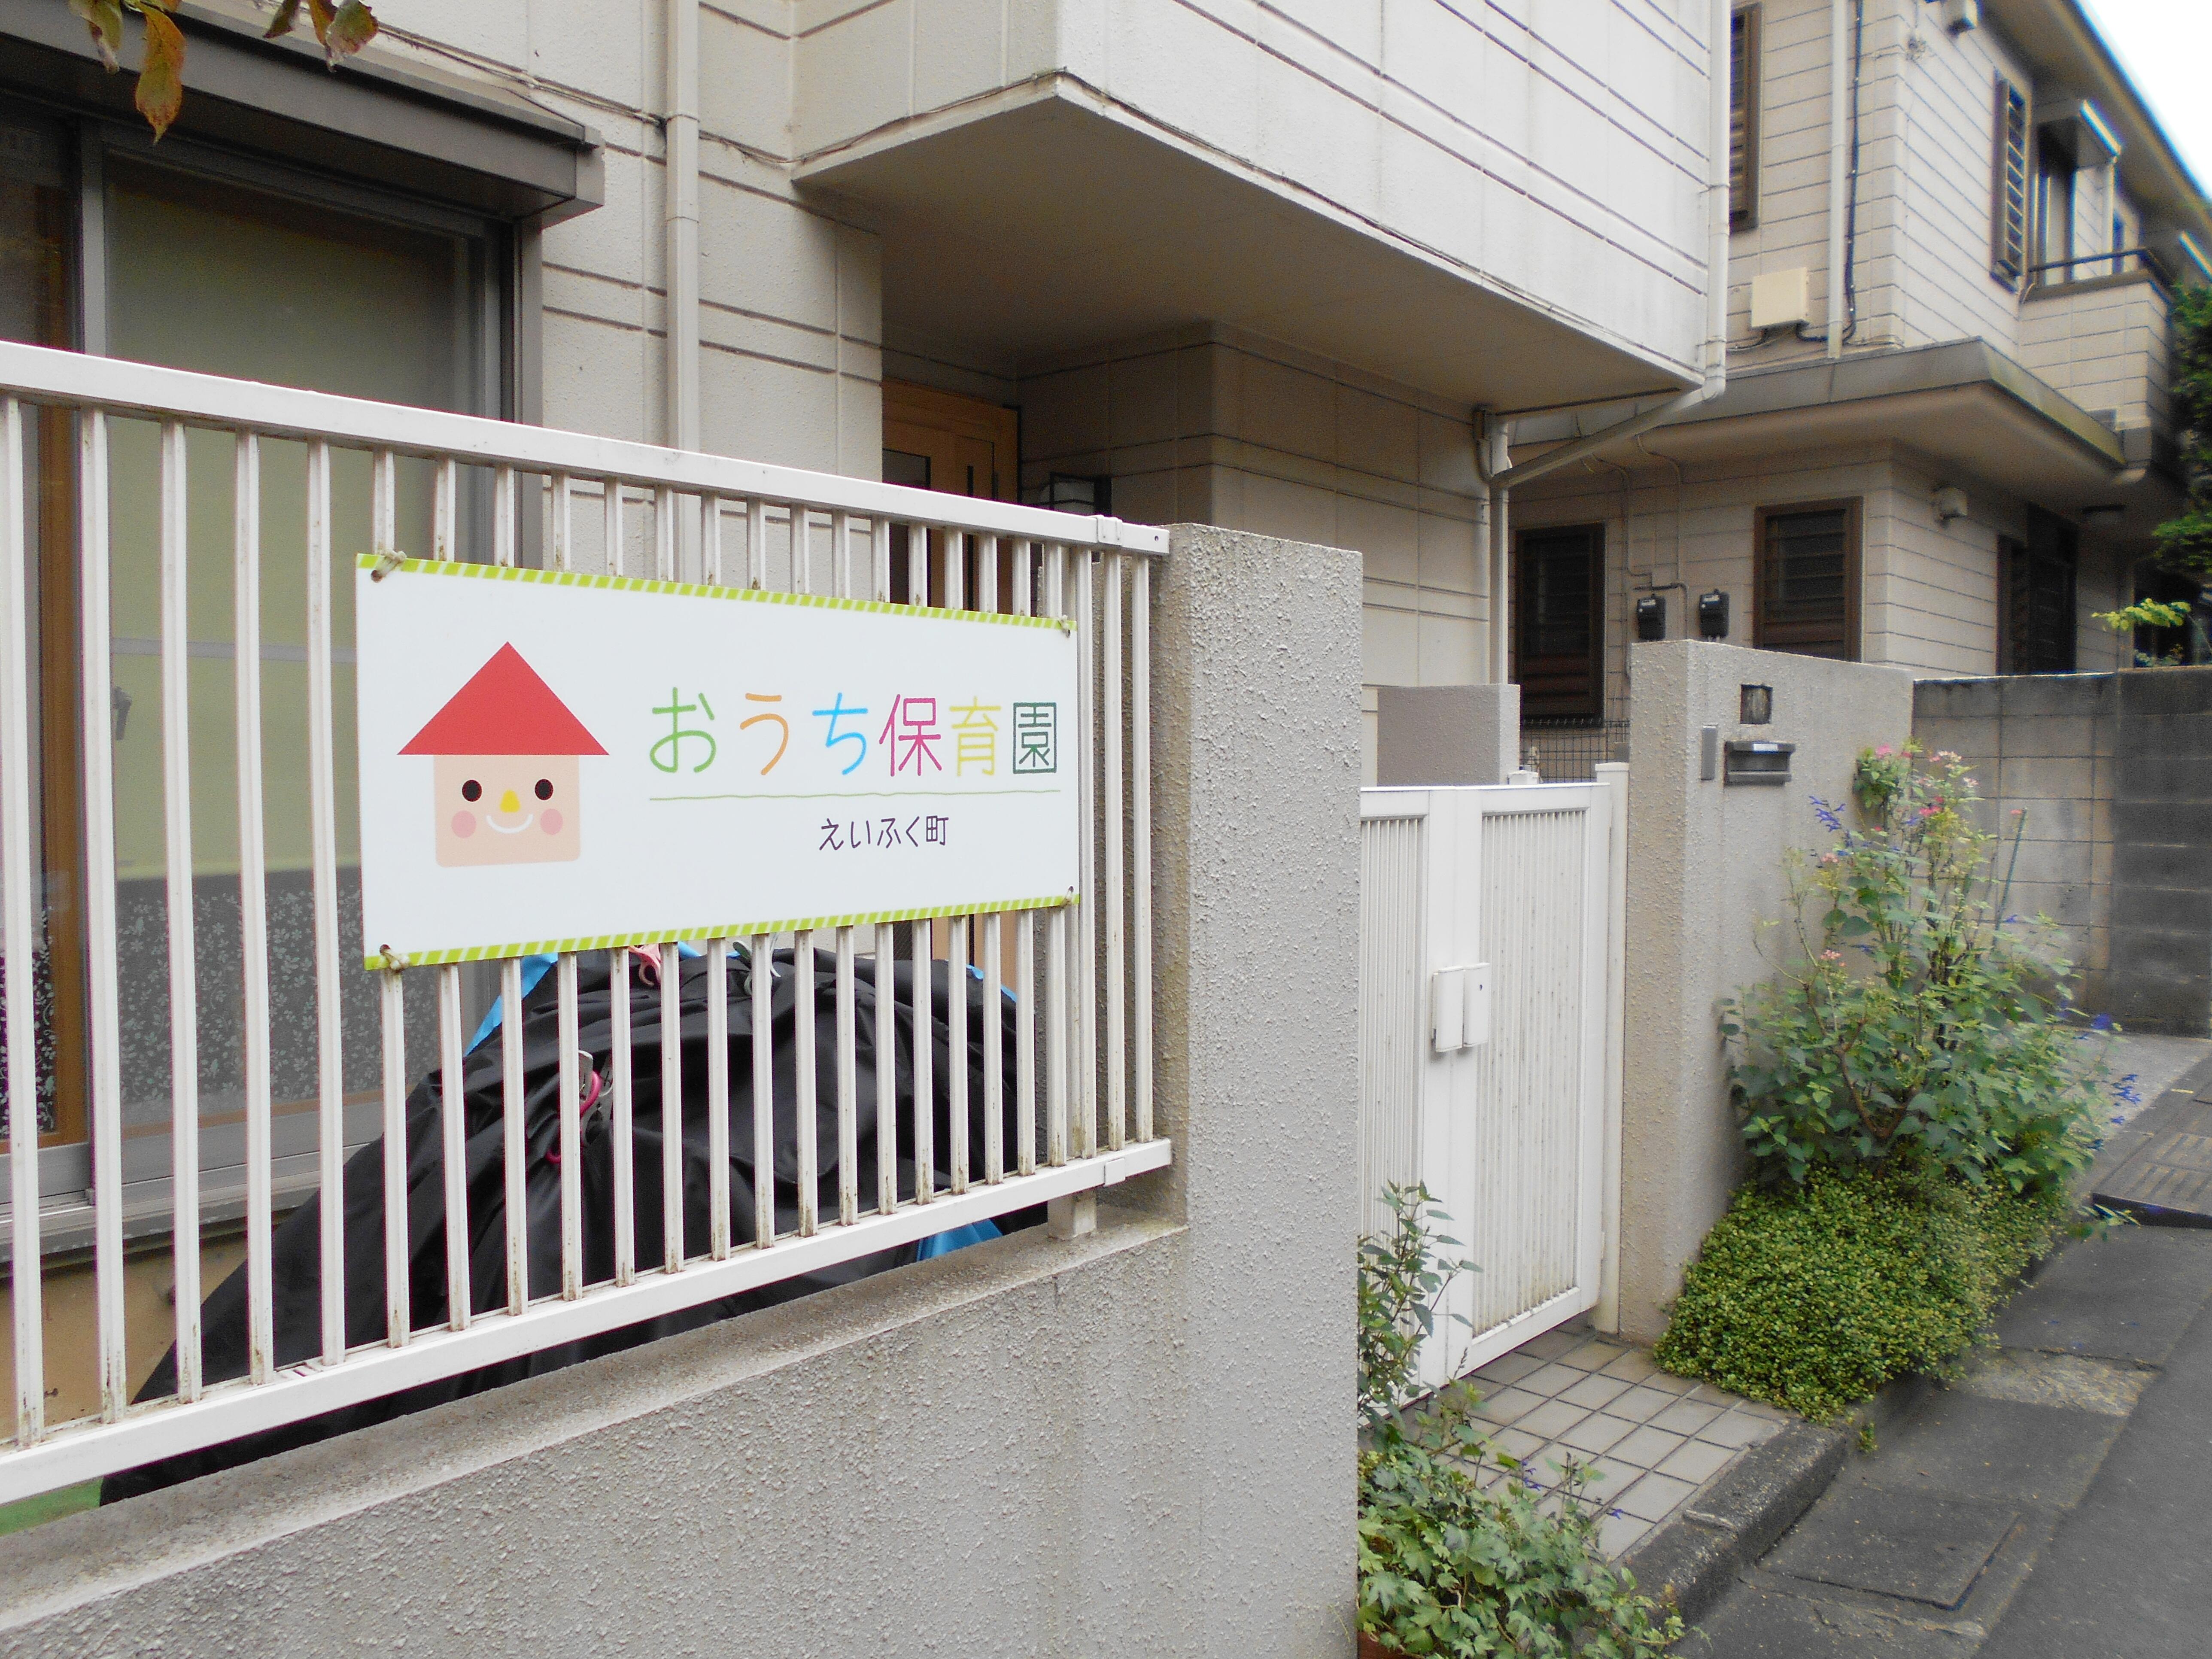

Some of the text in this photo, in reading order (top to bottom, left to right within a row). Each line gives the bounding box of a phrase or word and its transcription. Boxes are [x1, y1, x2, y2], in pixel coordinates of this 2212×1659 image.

[649, 687, 1057, 777] おうち保育園
[819, 815, 949, 851] えいふく町
